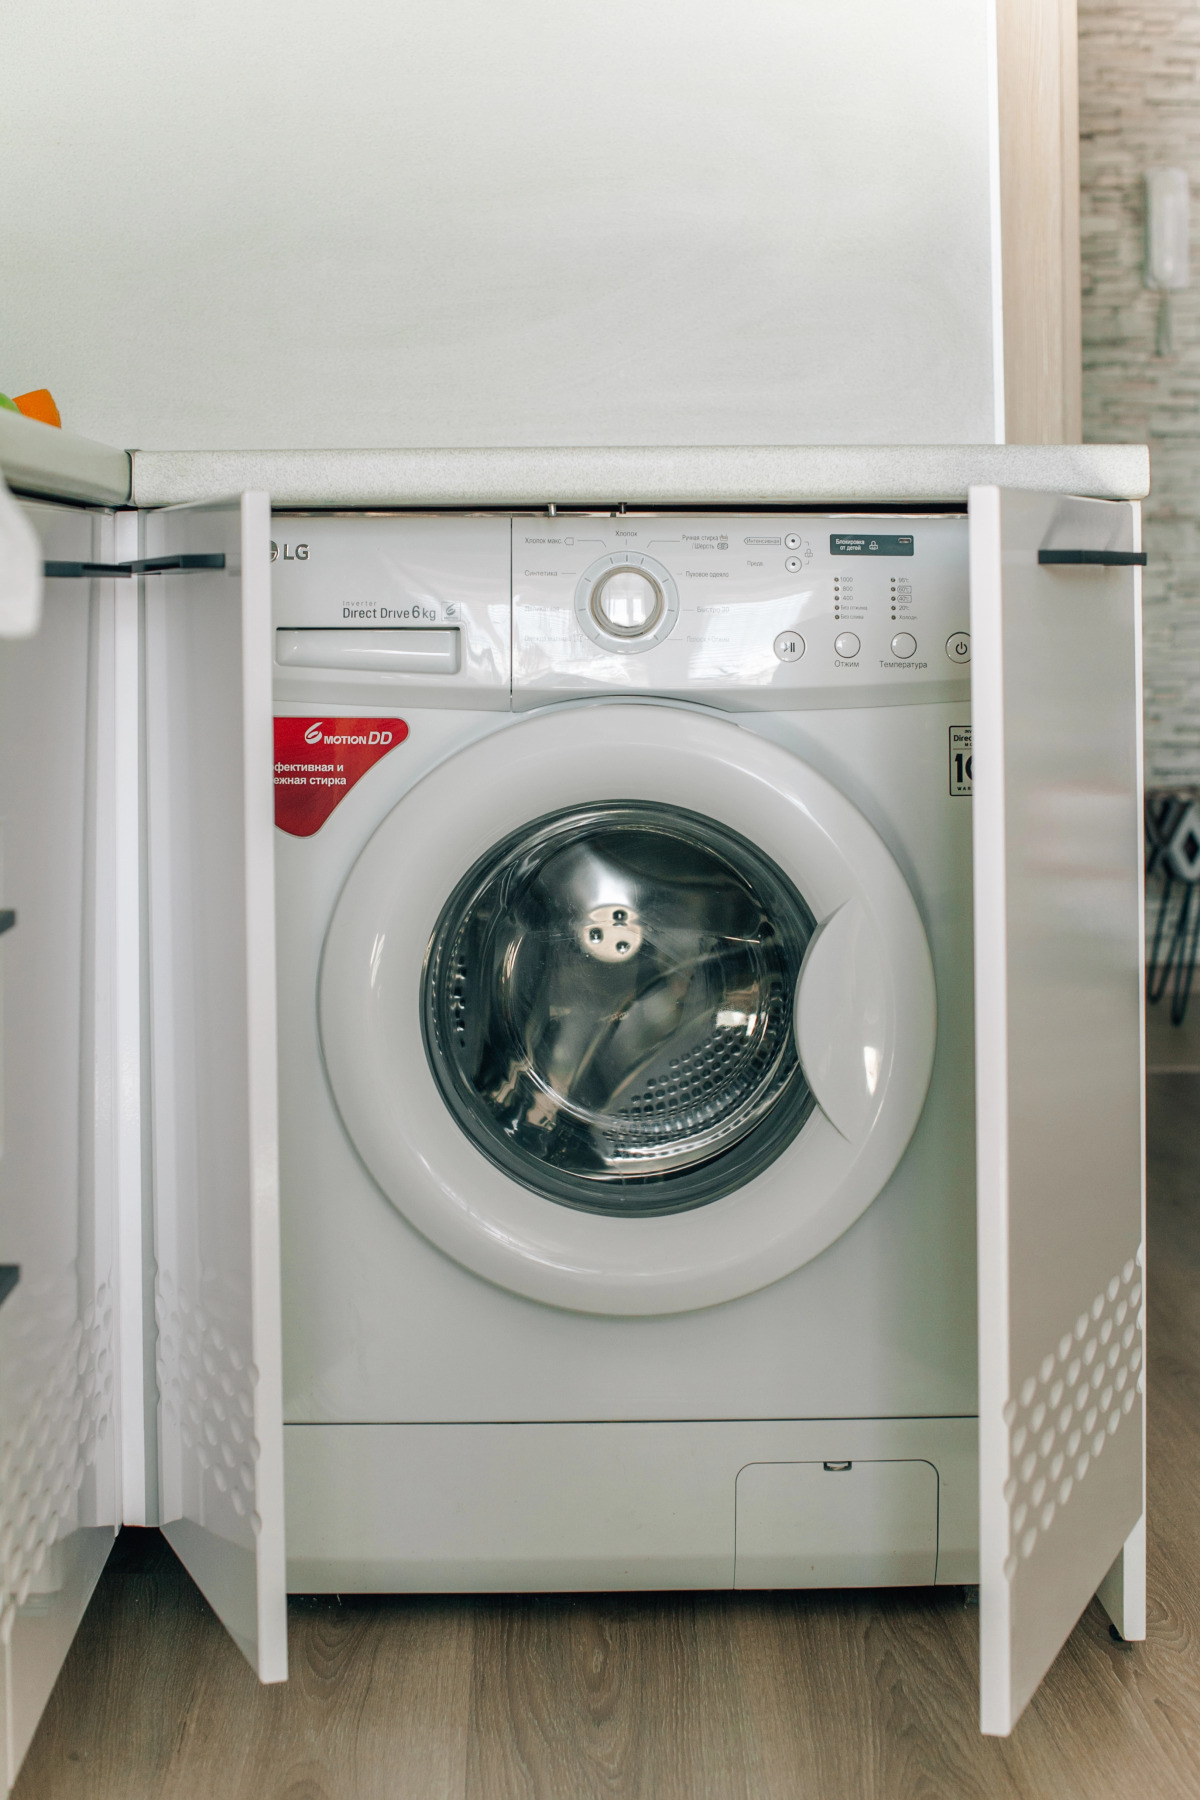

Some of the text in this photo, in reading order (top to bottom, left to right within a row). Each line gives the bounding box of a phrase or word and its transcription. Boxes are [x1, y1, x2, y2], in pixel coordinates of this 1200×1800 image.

[525, 536, 547, 544] Хлопок
[682, 534, 700, 542] Ручная
[835, 538, 865, 546] Блокировка
[283, 543, 310, 560] LG
[524, 569, 558, 577] Синтетика
[685, 570, 709, 578] Пуховое
[343, 607, 377, 618] Direct
[380, 607, 410, 618] Drive
[411, 605, 421, 618] 6
[422, 607, 436, 621] kg
[696, 606, 720, 614] Быстро
[834, 659, 860, 668] Отжим
[879, 660, 928, 670] Температура
[323, 735, 367, 745] MOTION
[367, 731, 393, 745] DD
[336, 764, 344, 772] и
[309, 777, 347, 788] стирка
